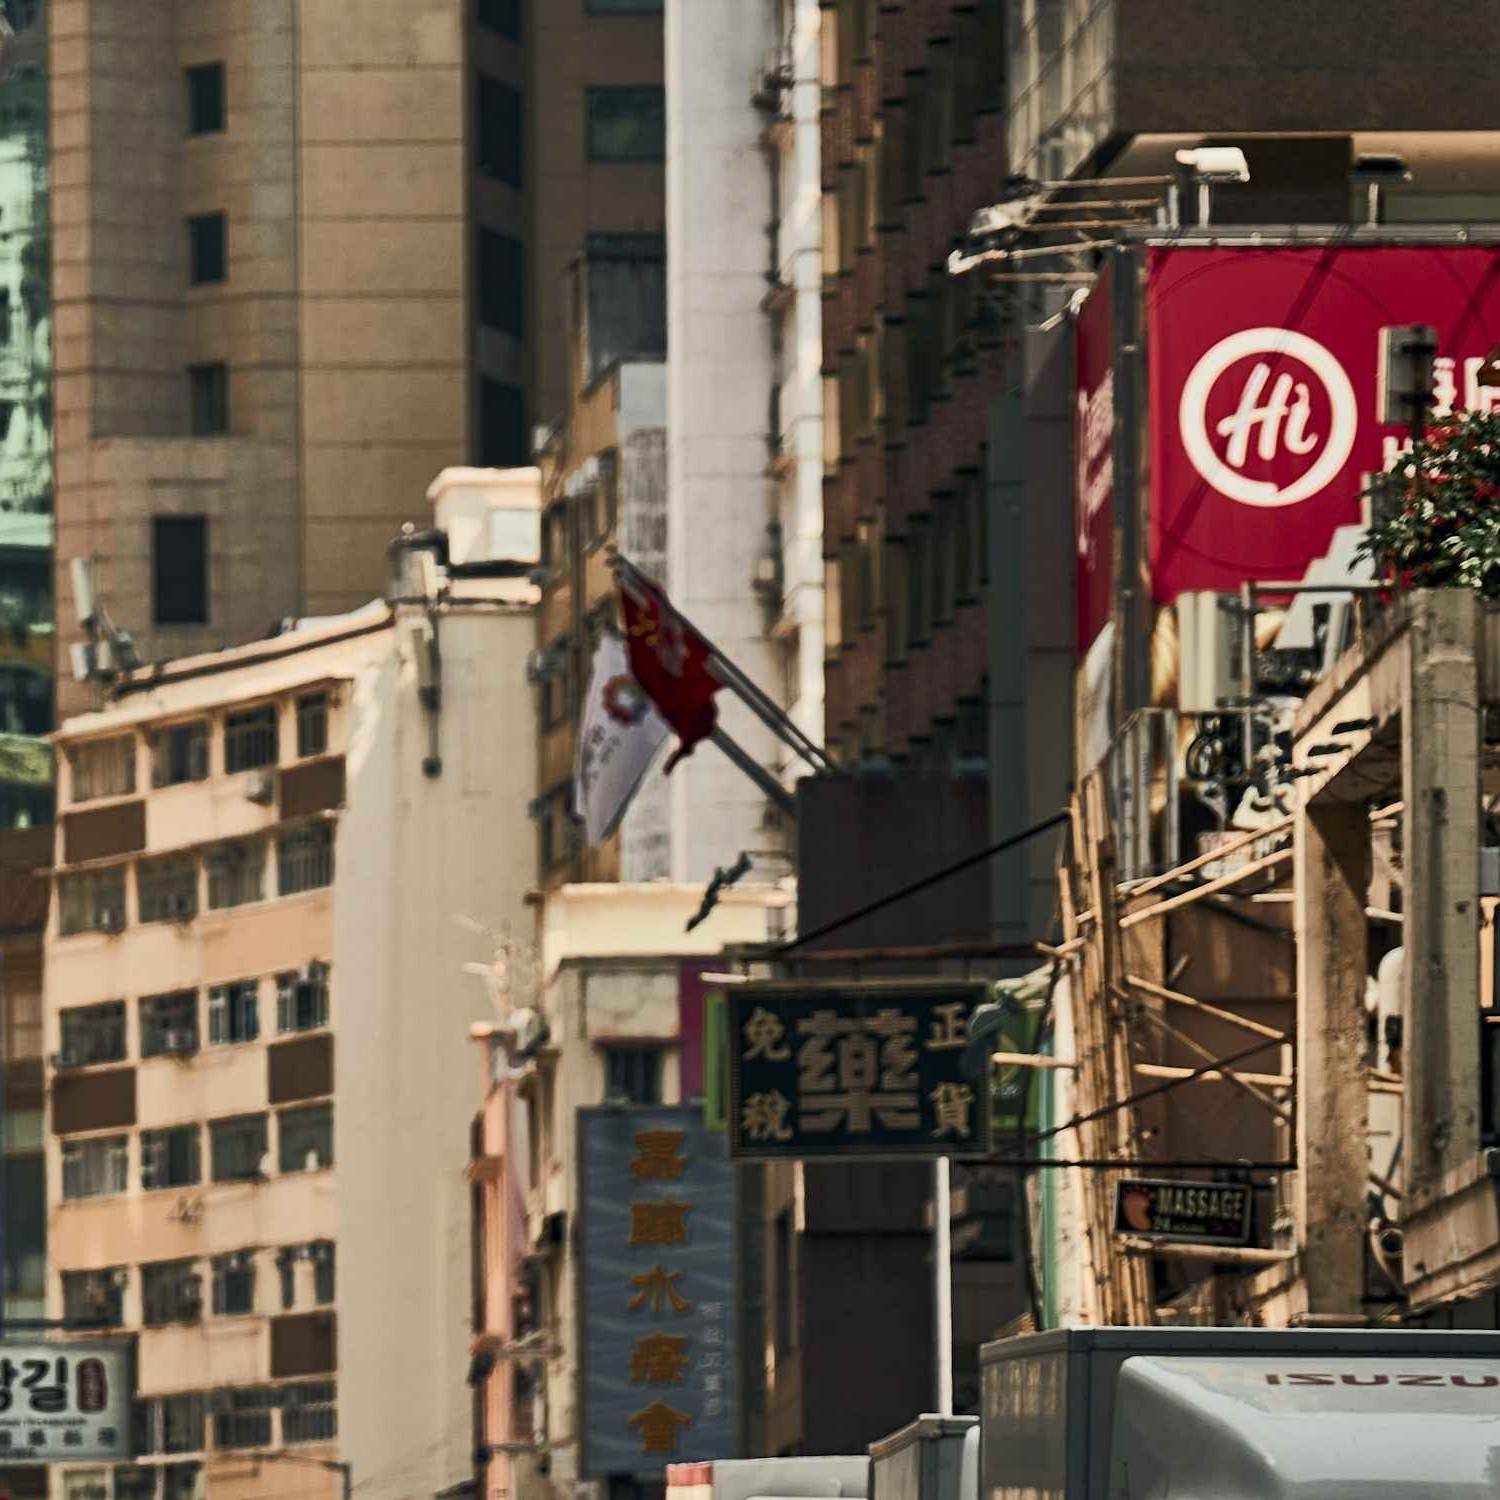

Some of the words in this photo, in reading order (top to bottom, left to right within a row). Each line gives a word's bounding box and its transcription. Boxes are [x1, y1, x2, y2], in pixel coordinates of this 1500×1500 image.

[1216, 361, 1319, 468] Hi
[795, 1007, 921, 1133] 藥
[1156, 1186, 1244, 1220] MASSAGE
[1265, 1373, 1500, 1387] ISUZU
